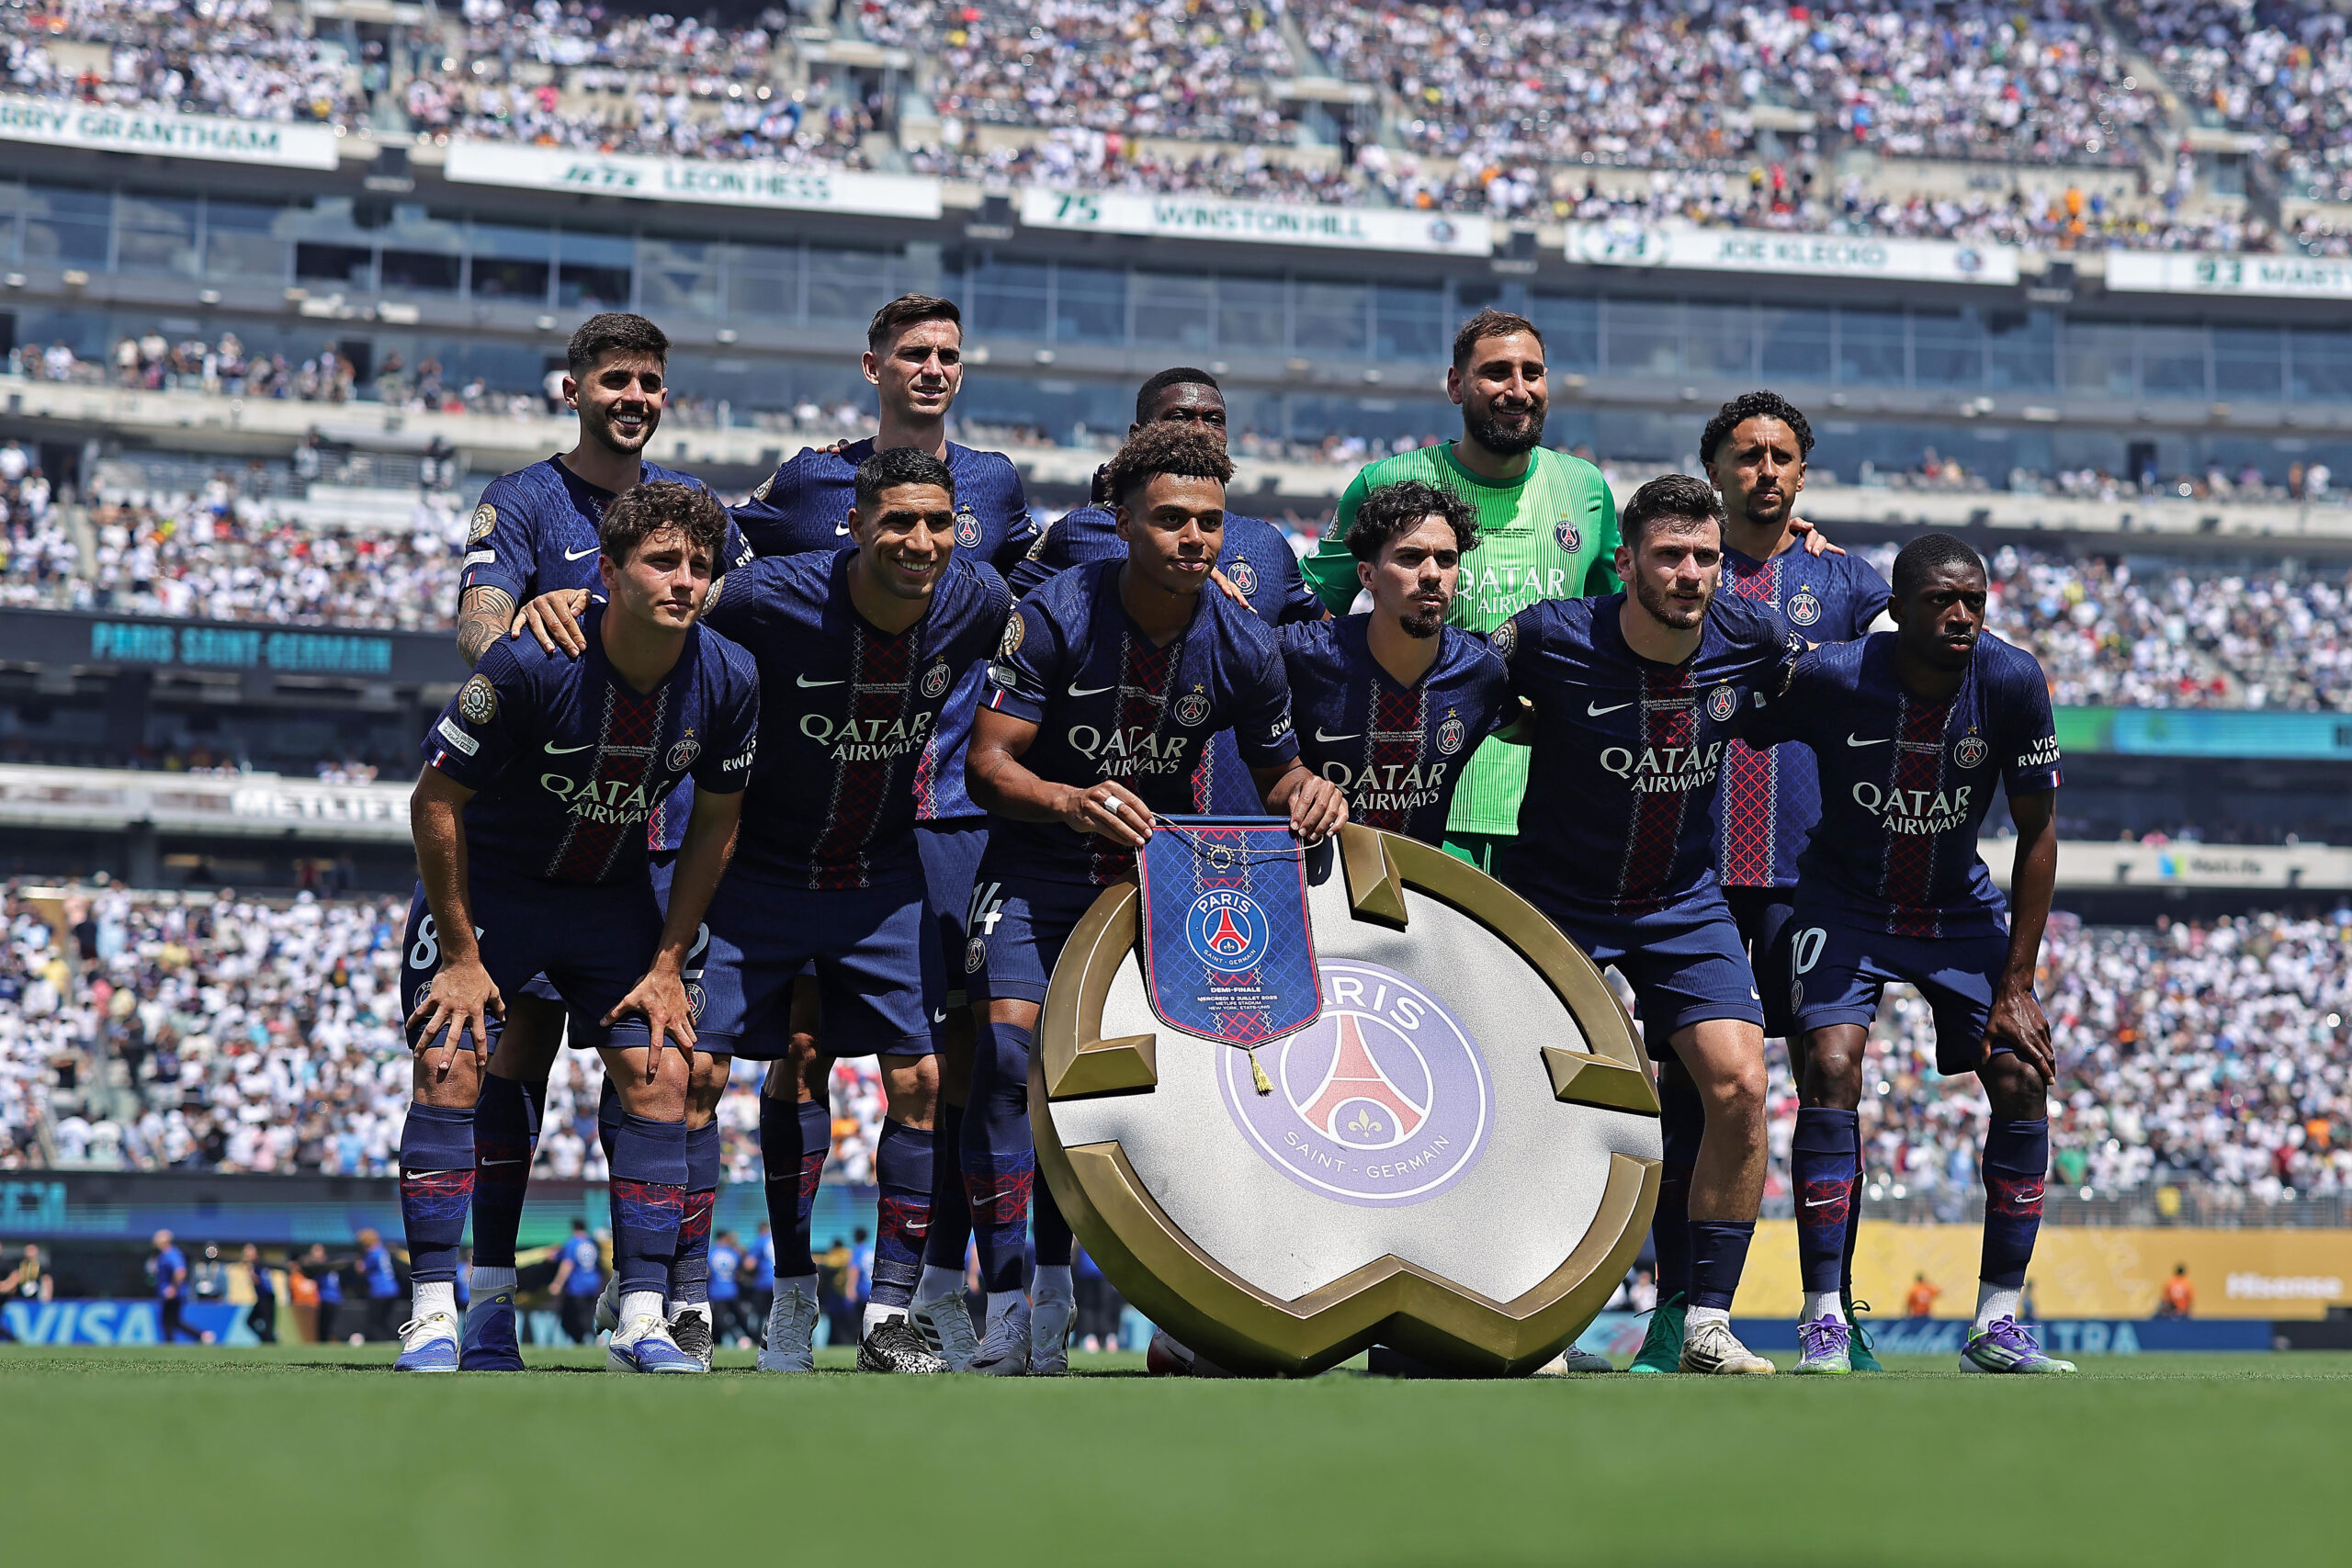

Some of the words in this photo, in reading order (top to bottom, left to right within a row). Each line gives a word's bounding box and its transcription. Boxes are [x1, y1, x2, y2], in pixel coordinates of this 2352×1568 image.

[78, 113, 281, 152] GRANTHAM
[663, 164, 745, 191] LEON
[753, 171, 832, 199] HESS
[1052, 193, 1100, 222] 75
[1152, 200, 1299, 234] WINSTON
[1307, 208, 1369, 238] HILL
[1716, 236, 1768, 262] JOE
[1773, 239, 1888, 267] KLECKO
[2196, 259, 2242, 284] 93
[2258, 263, 2352, 287] MART
[956, 515, 977, 525] PARIS
[1231, 563, 1251, 574] PARIS
[1457, 566, 1566, 602] QATAR
[1476, 596, 1542, 614] AIRW
[1792, 594, 1815, 605] PARIS
[91, 620, 175, 664] PARIS
[462, 685, 470, 700] CLUB
[471, 679, 486, 688] WORLD
[1712, 686, 1732, 697] PARIS
[462, 704, 476, 720] FIFA
[1182, 695, 1206, 705] PARIS
[478, 710, 489, 719] USA
[799, 711, 932, 746] QATAR
[1442, 721, 1462, 731] PARIS
[674, 741, 698, 750] PARIS
[831, 733, 926, 761] AIRWAYS
[1068, 725, 1188, 761] QATAR
[1960, 739, 1984, 748] PARIS
[1096, 755, 1180, 776] AIRWAYS
[1600, 740, 1723, 779] QATAR
[1322, 761, 1447, 795] QATAR
[1631, 765, 1717, 793] AIRWAYS
[1351, 787, 1440, 810] AIRWAYS
[1852, 782, 1972, 817] QATAR
[566, 802, 650, 824] AIRWAY
[1882, 807, 1968, 835] AIRWAYS
[966, 882, 1003, 938] 14
[1197, 893, 1252, 915] PARIS
[682, 921, 710, 979] 2
[1203, 949, 1225, 964] SAINT
[1228, 948, 1257, 965] GERMAIN
[1791, 927, 1827, 981] 10
[687, 986, 699, 995] RIS
[1323, 976, 1426, 1031] RIS
[1283, 1131, 1346, 1173] SAINT
[1366, 1134, 1451, 1179] GERMAIN
[5, 1301, 160, 1346] VISA
[2043, 1319, 2142, 1356] LTRA
